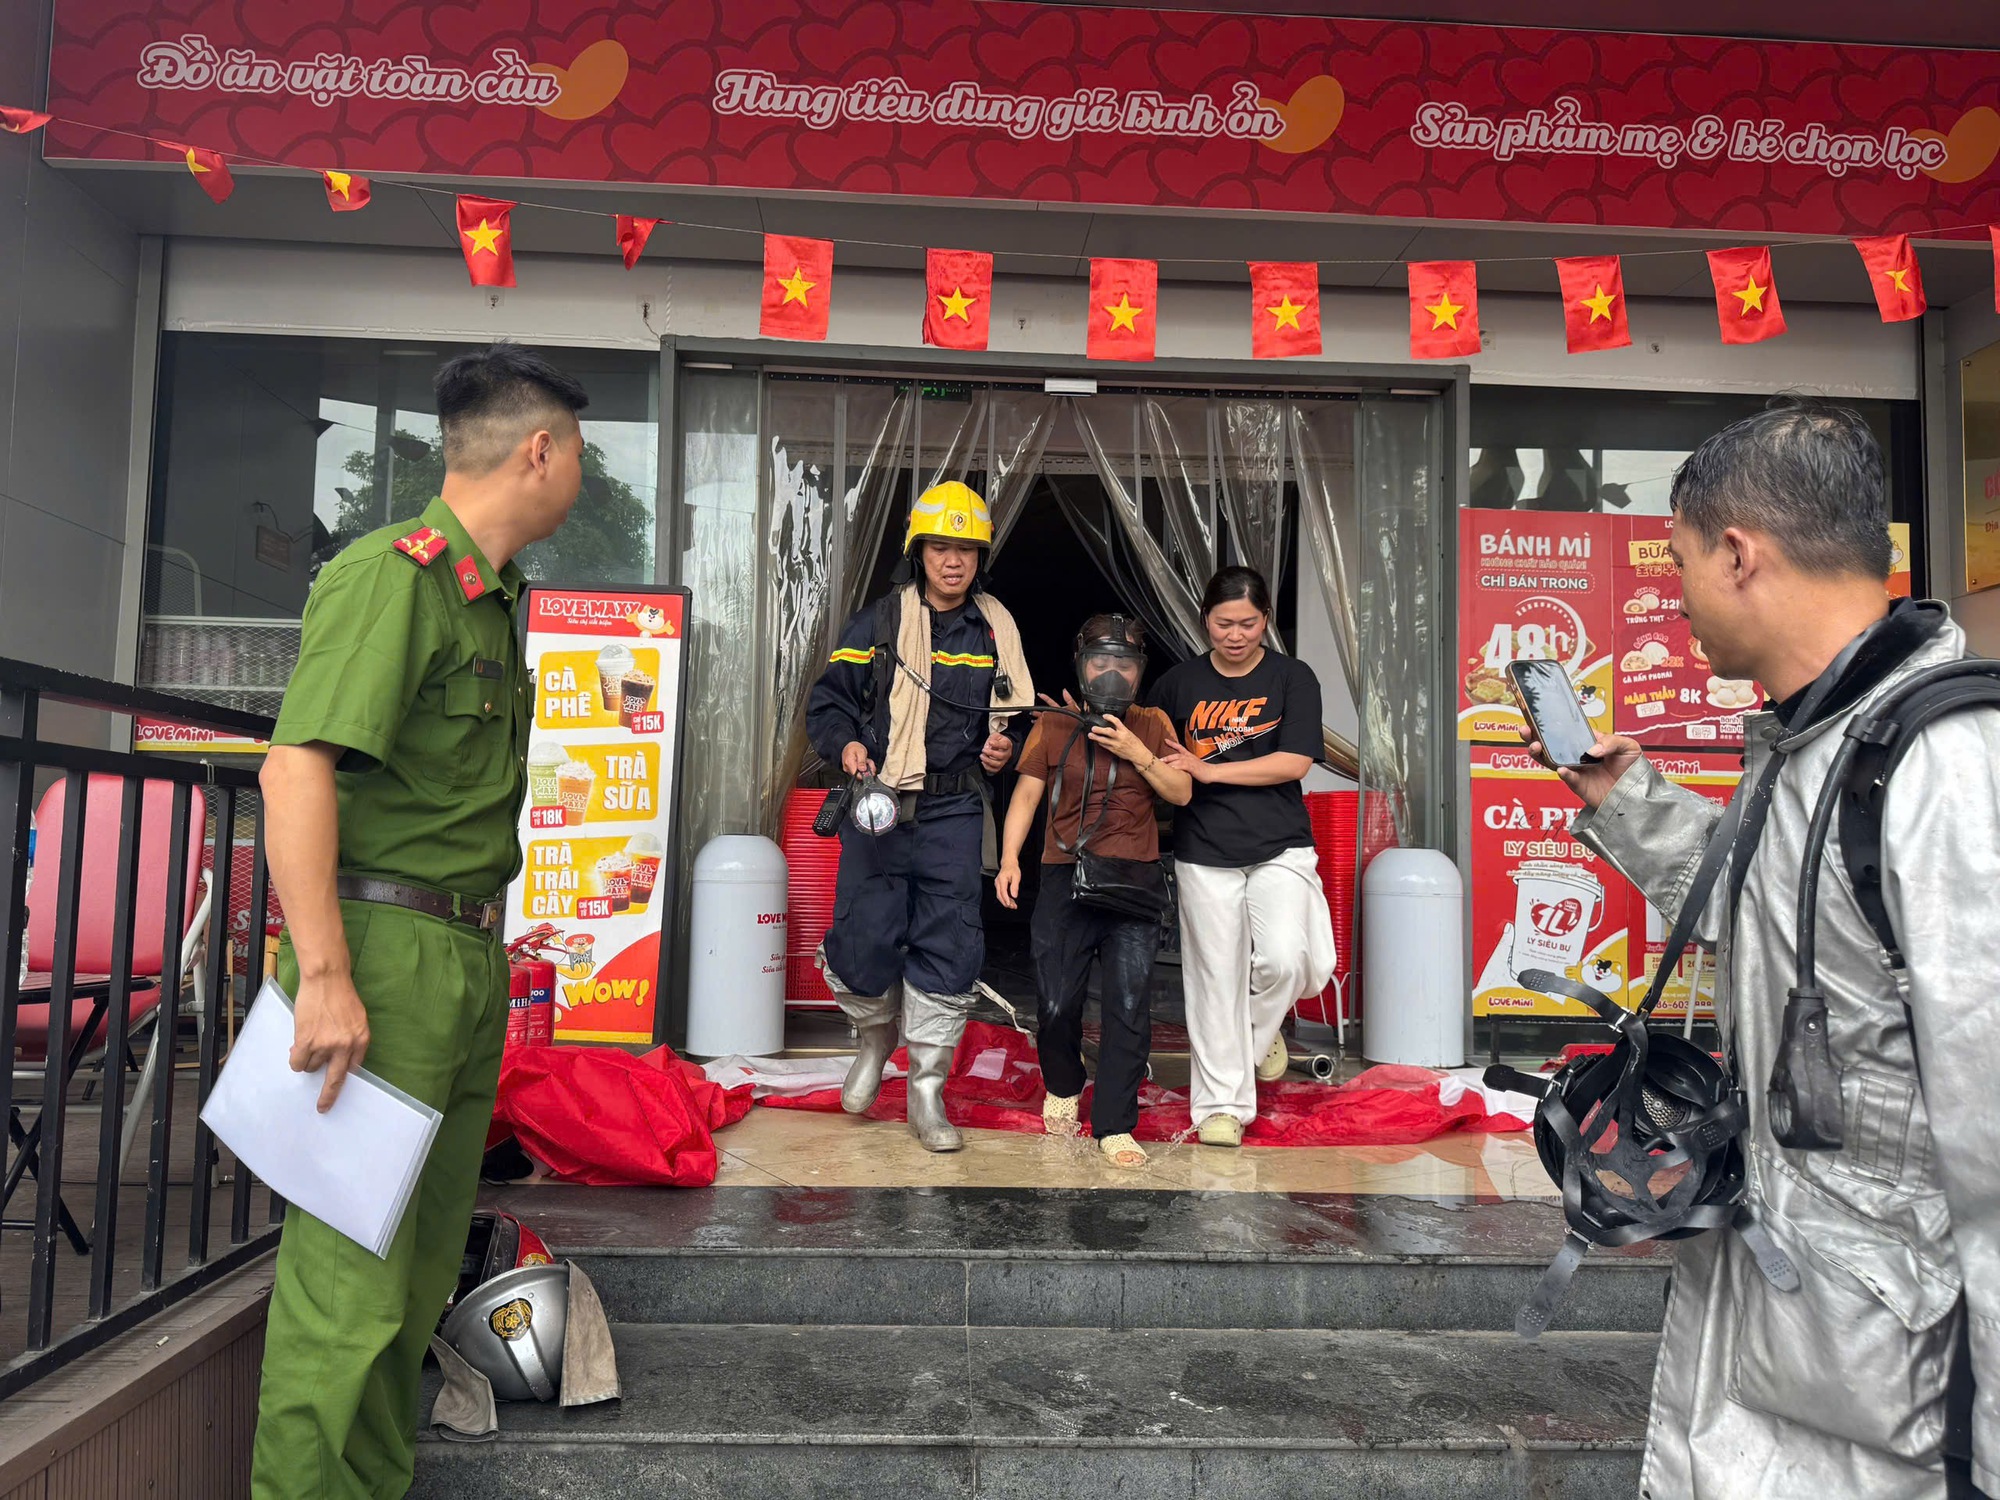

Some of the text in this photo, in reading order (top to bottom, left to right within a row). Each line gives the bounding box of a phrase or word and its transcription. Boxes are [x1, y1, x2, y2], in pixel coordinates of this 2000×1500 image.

[139, 35, 560, 105] Đồ ăn vặt toàn cầu
[715, 70, 1285, 139] Hàng tiêu dùng giá bình ổn
[1413, 97, 1946, 179] Sản phẩm mẹ & bé chọn lọc
[1480, 528, 1591, 558] BÁNH MÌ
[1638, 542, 1672, 559] BỮA
[1481, 574, 1588, 590] CHỈ BÁN TRONG
[539, 597, 641, 619] LOVE MAXX
[545, 666, 577, 692] CÀ
[545, 691, 592, 718] PHÊ
[1679, 687, 1702, 704] 8K
[641, 714, 662, 731] 15K
[1189, 697, 1268, 731] NIKE
[135, 724, 174, 742] LOVE
[1474, 722, 1496, 731] LOVE
[605, 750, 647, 780] TRÀ
[1491, 753, 1530, 769] LOVE
[603, 780, 651, 811] SỮA
[541, 809, 563, 825] 18K
[1484, 797, 1532, 830] CÀ
[532, 841, 572, 866] TRÀ
[1503, 840, 1526, 857] LY
[1526, 838, 1569, 858] SIÊU
[532, 866, 579, 891] TRÁI
[532, 890, 574, 915] CÂY
[587, 899, 610, 916] 15K
[757, 913, 781, 925] LOVE
[1527, 936, 1536, 945] LY
[1488, 996, 1511, 1007] LOVE
